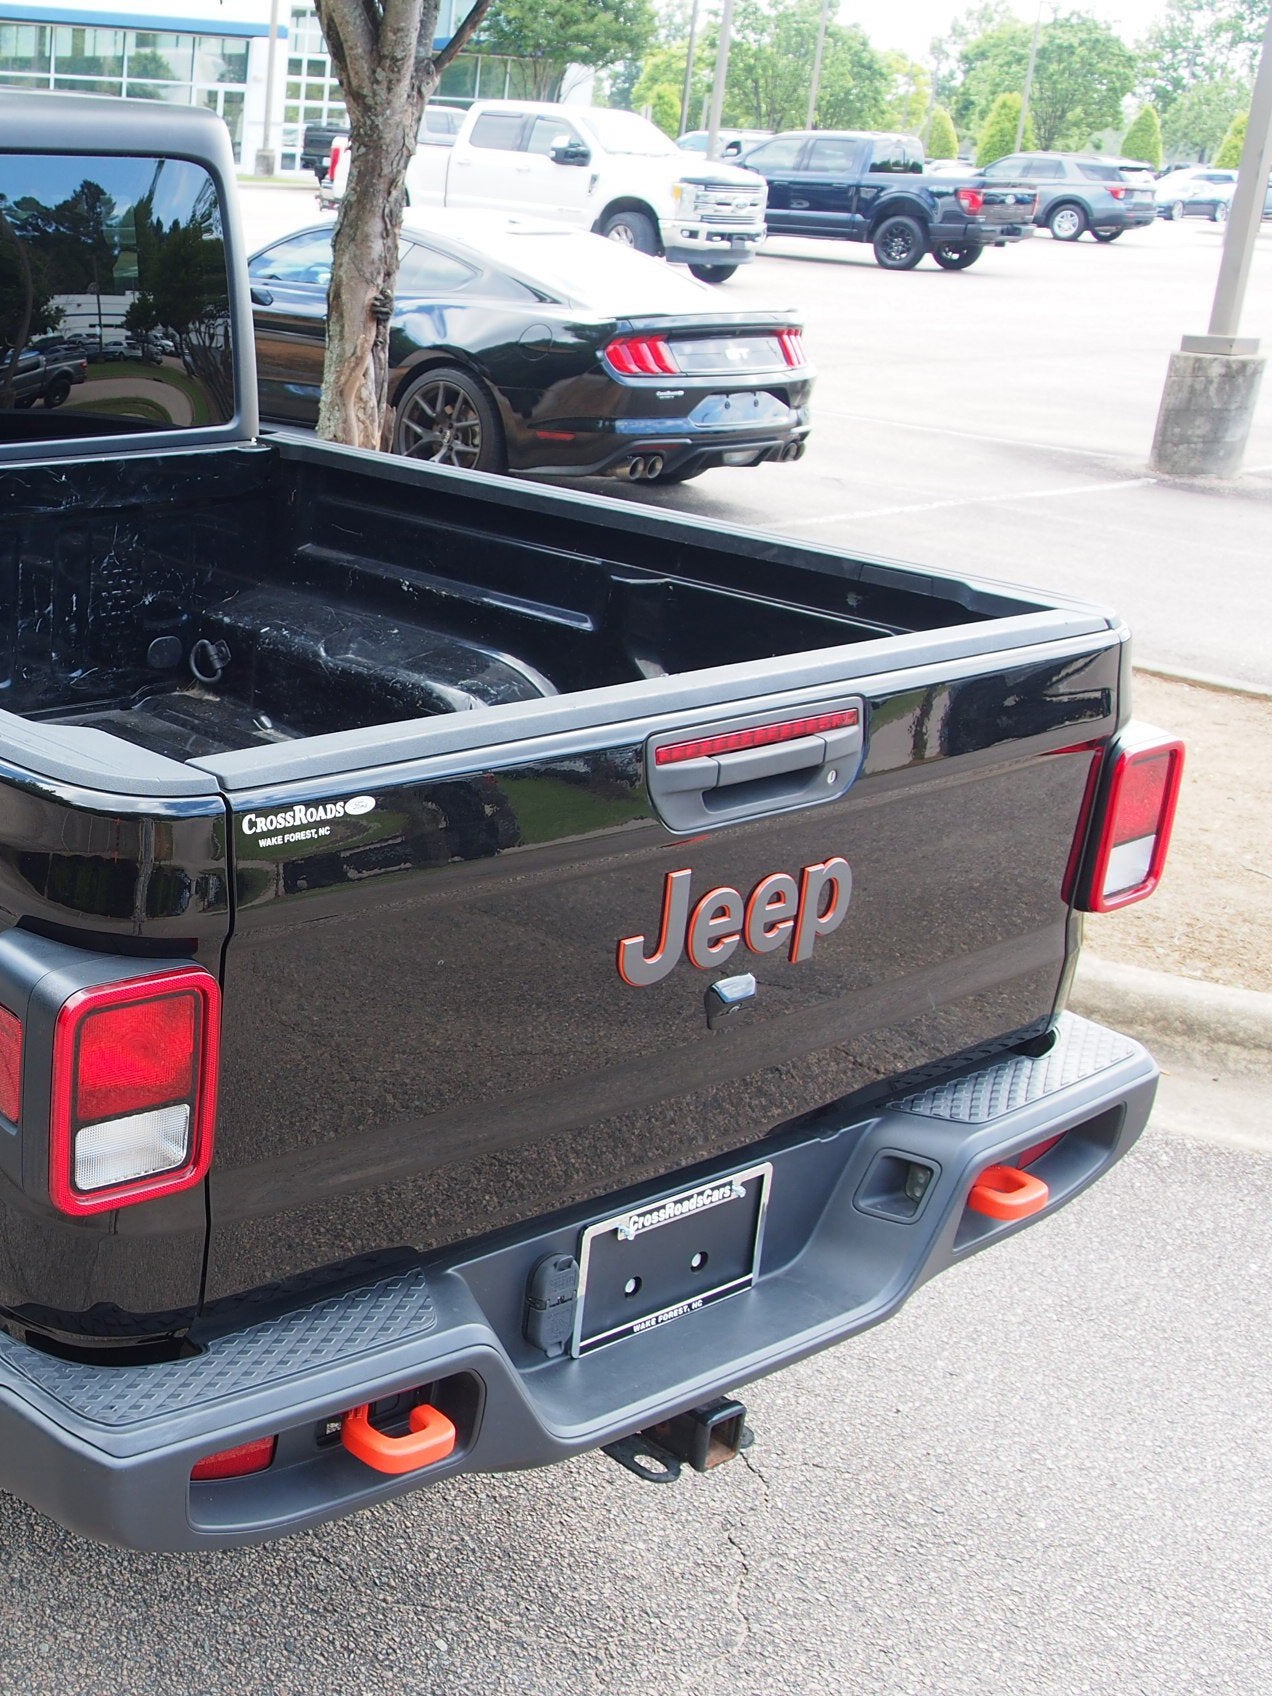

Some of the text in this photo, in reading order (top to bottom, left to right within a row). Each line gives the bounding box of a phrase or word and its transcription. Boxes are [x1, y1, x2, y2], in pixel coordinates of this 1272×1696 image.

[258, 826, 331, 848] WAKE FOREST, NC
[616, 856, 853, 987] Jeep
[628, 1184, 732, 1233] CrossRoadsCars
[633, 1299, 703, 1333] WAKE FOREST, NC
